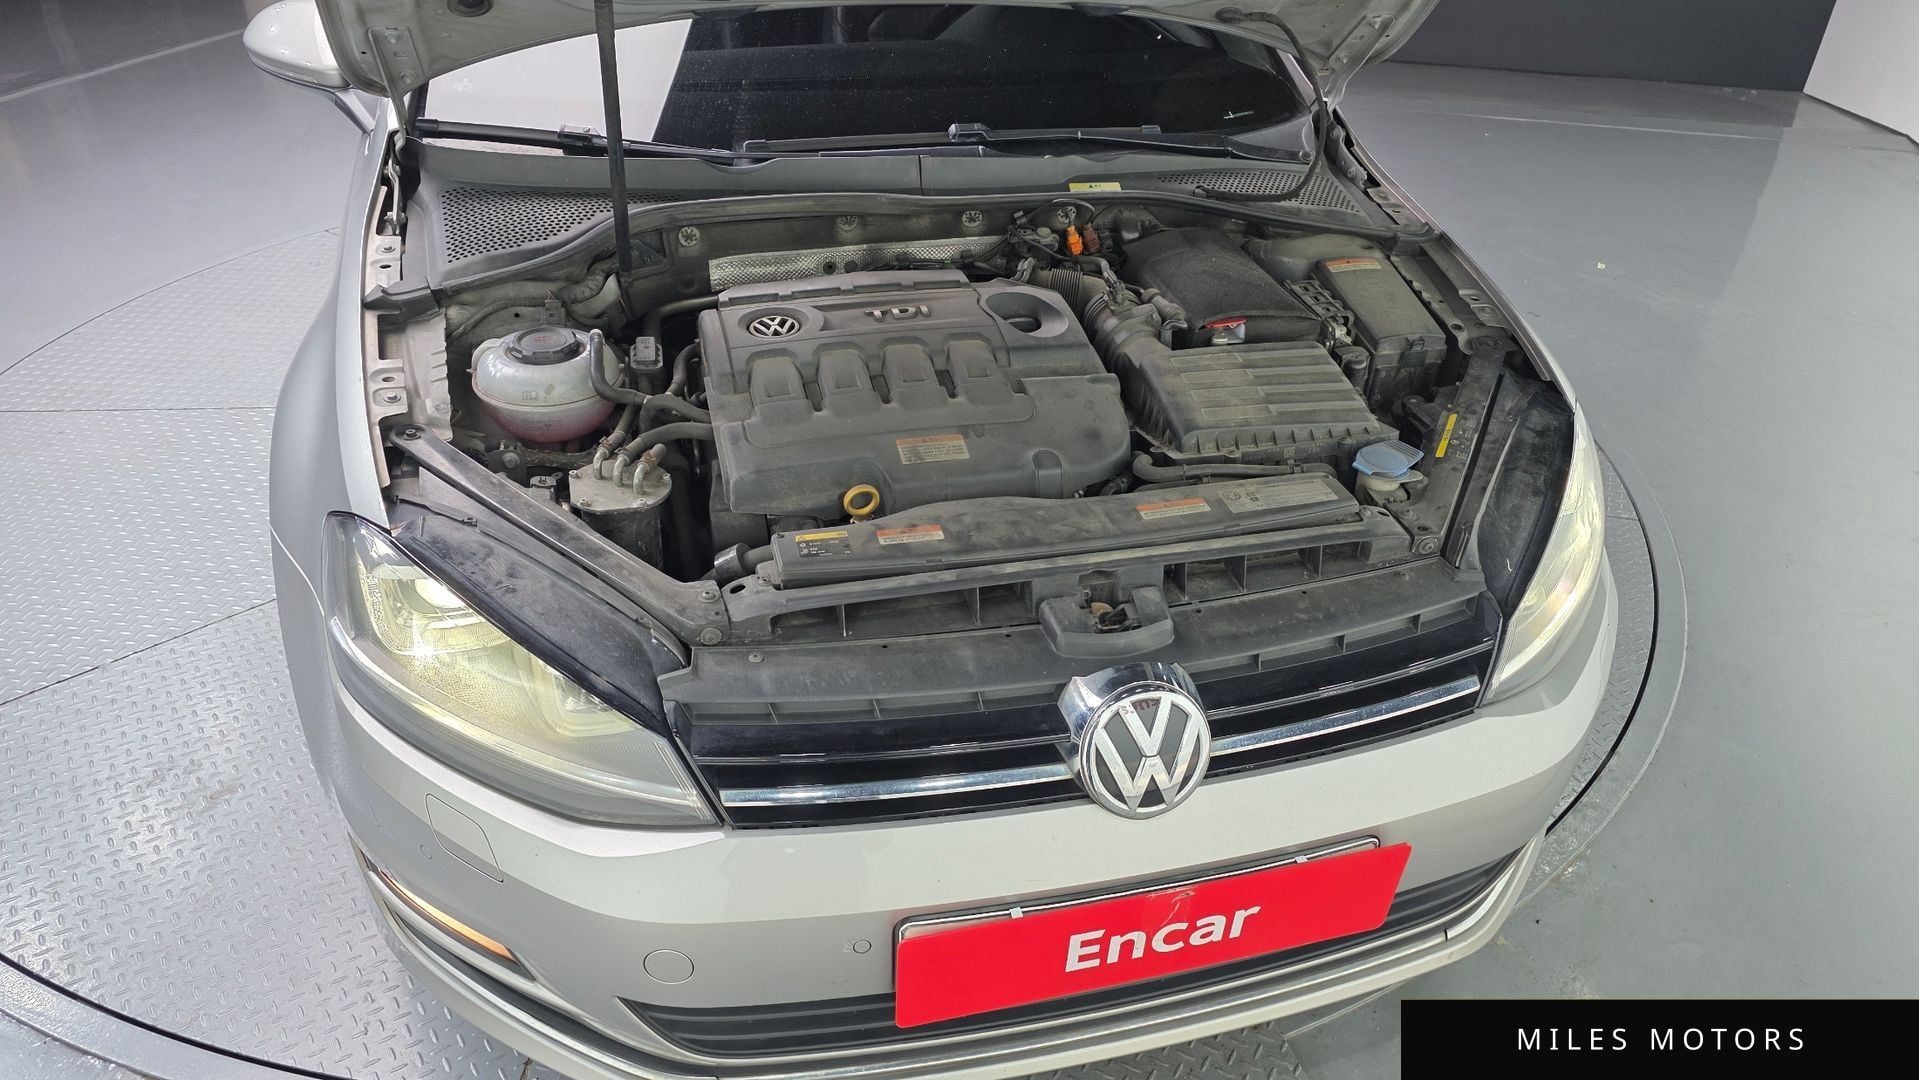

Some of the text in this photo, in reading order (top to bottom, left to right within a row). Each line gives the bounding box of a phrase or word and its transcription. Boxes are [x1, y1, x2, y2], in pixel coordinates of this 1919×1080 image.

[864, 304, 930, 321] TDI
[1088, 690, 1206, 818] VW
[1065, 906, 1262, 973] Encar
